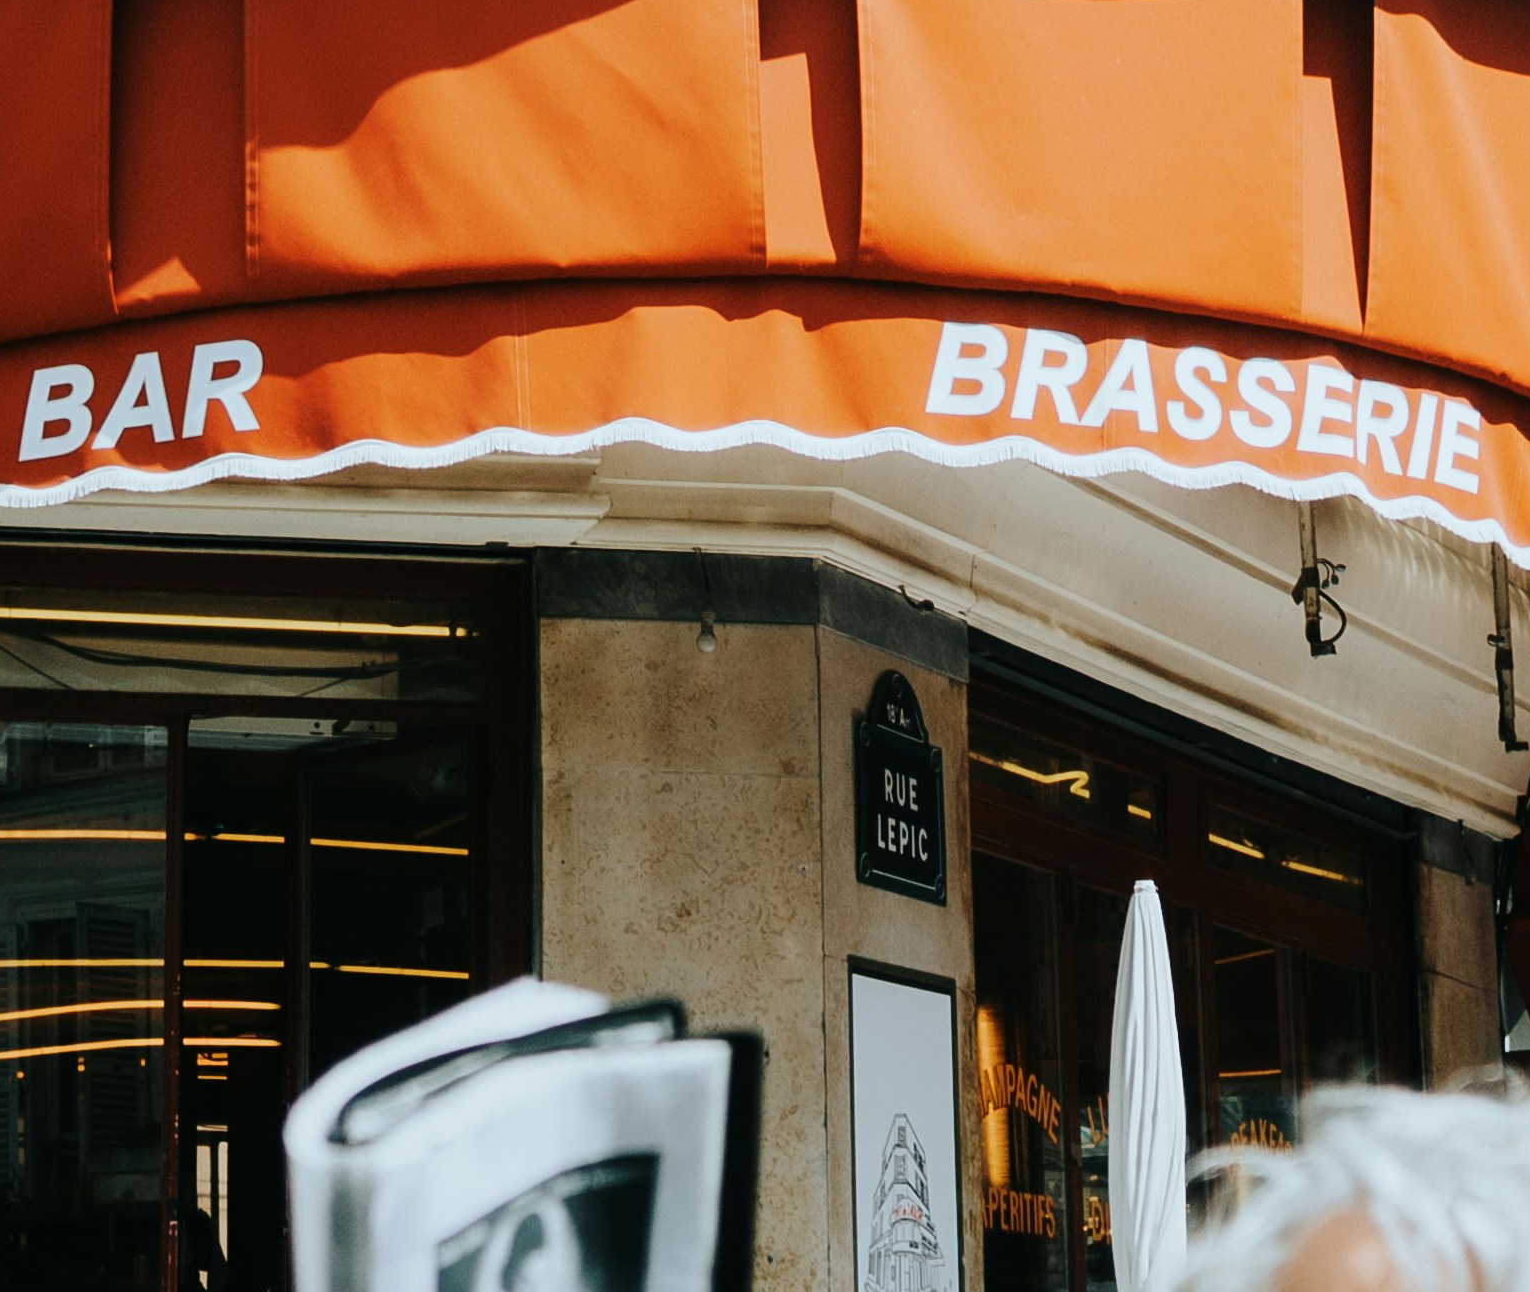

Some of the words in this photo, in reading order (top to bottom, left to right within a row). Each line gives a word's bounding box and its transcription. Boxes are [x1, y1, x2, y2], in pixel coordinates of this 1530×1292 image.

[18, 338, 265, 462] BAR
[924, 319, 1483, 495] BRASSERIE
[884, 768, 918, 811] RUE
[877, 813, 929, 862] LEPIC
[978, 1063, 1061, 1145] AMPAGNE
